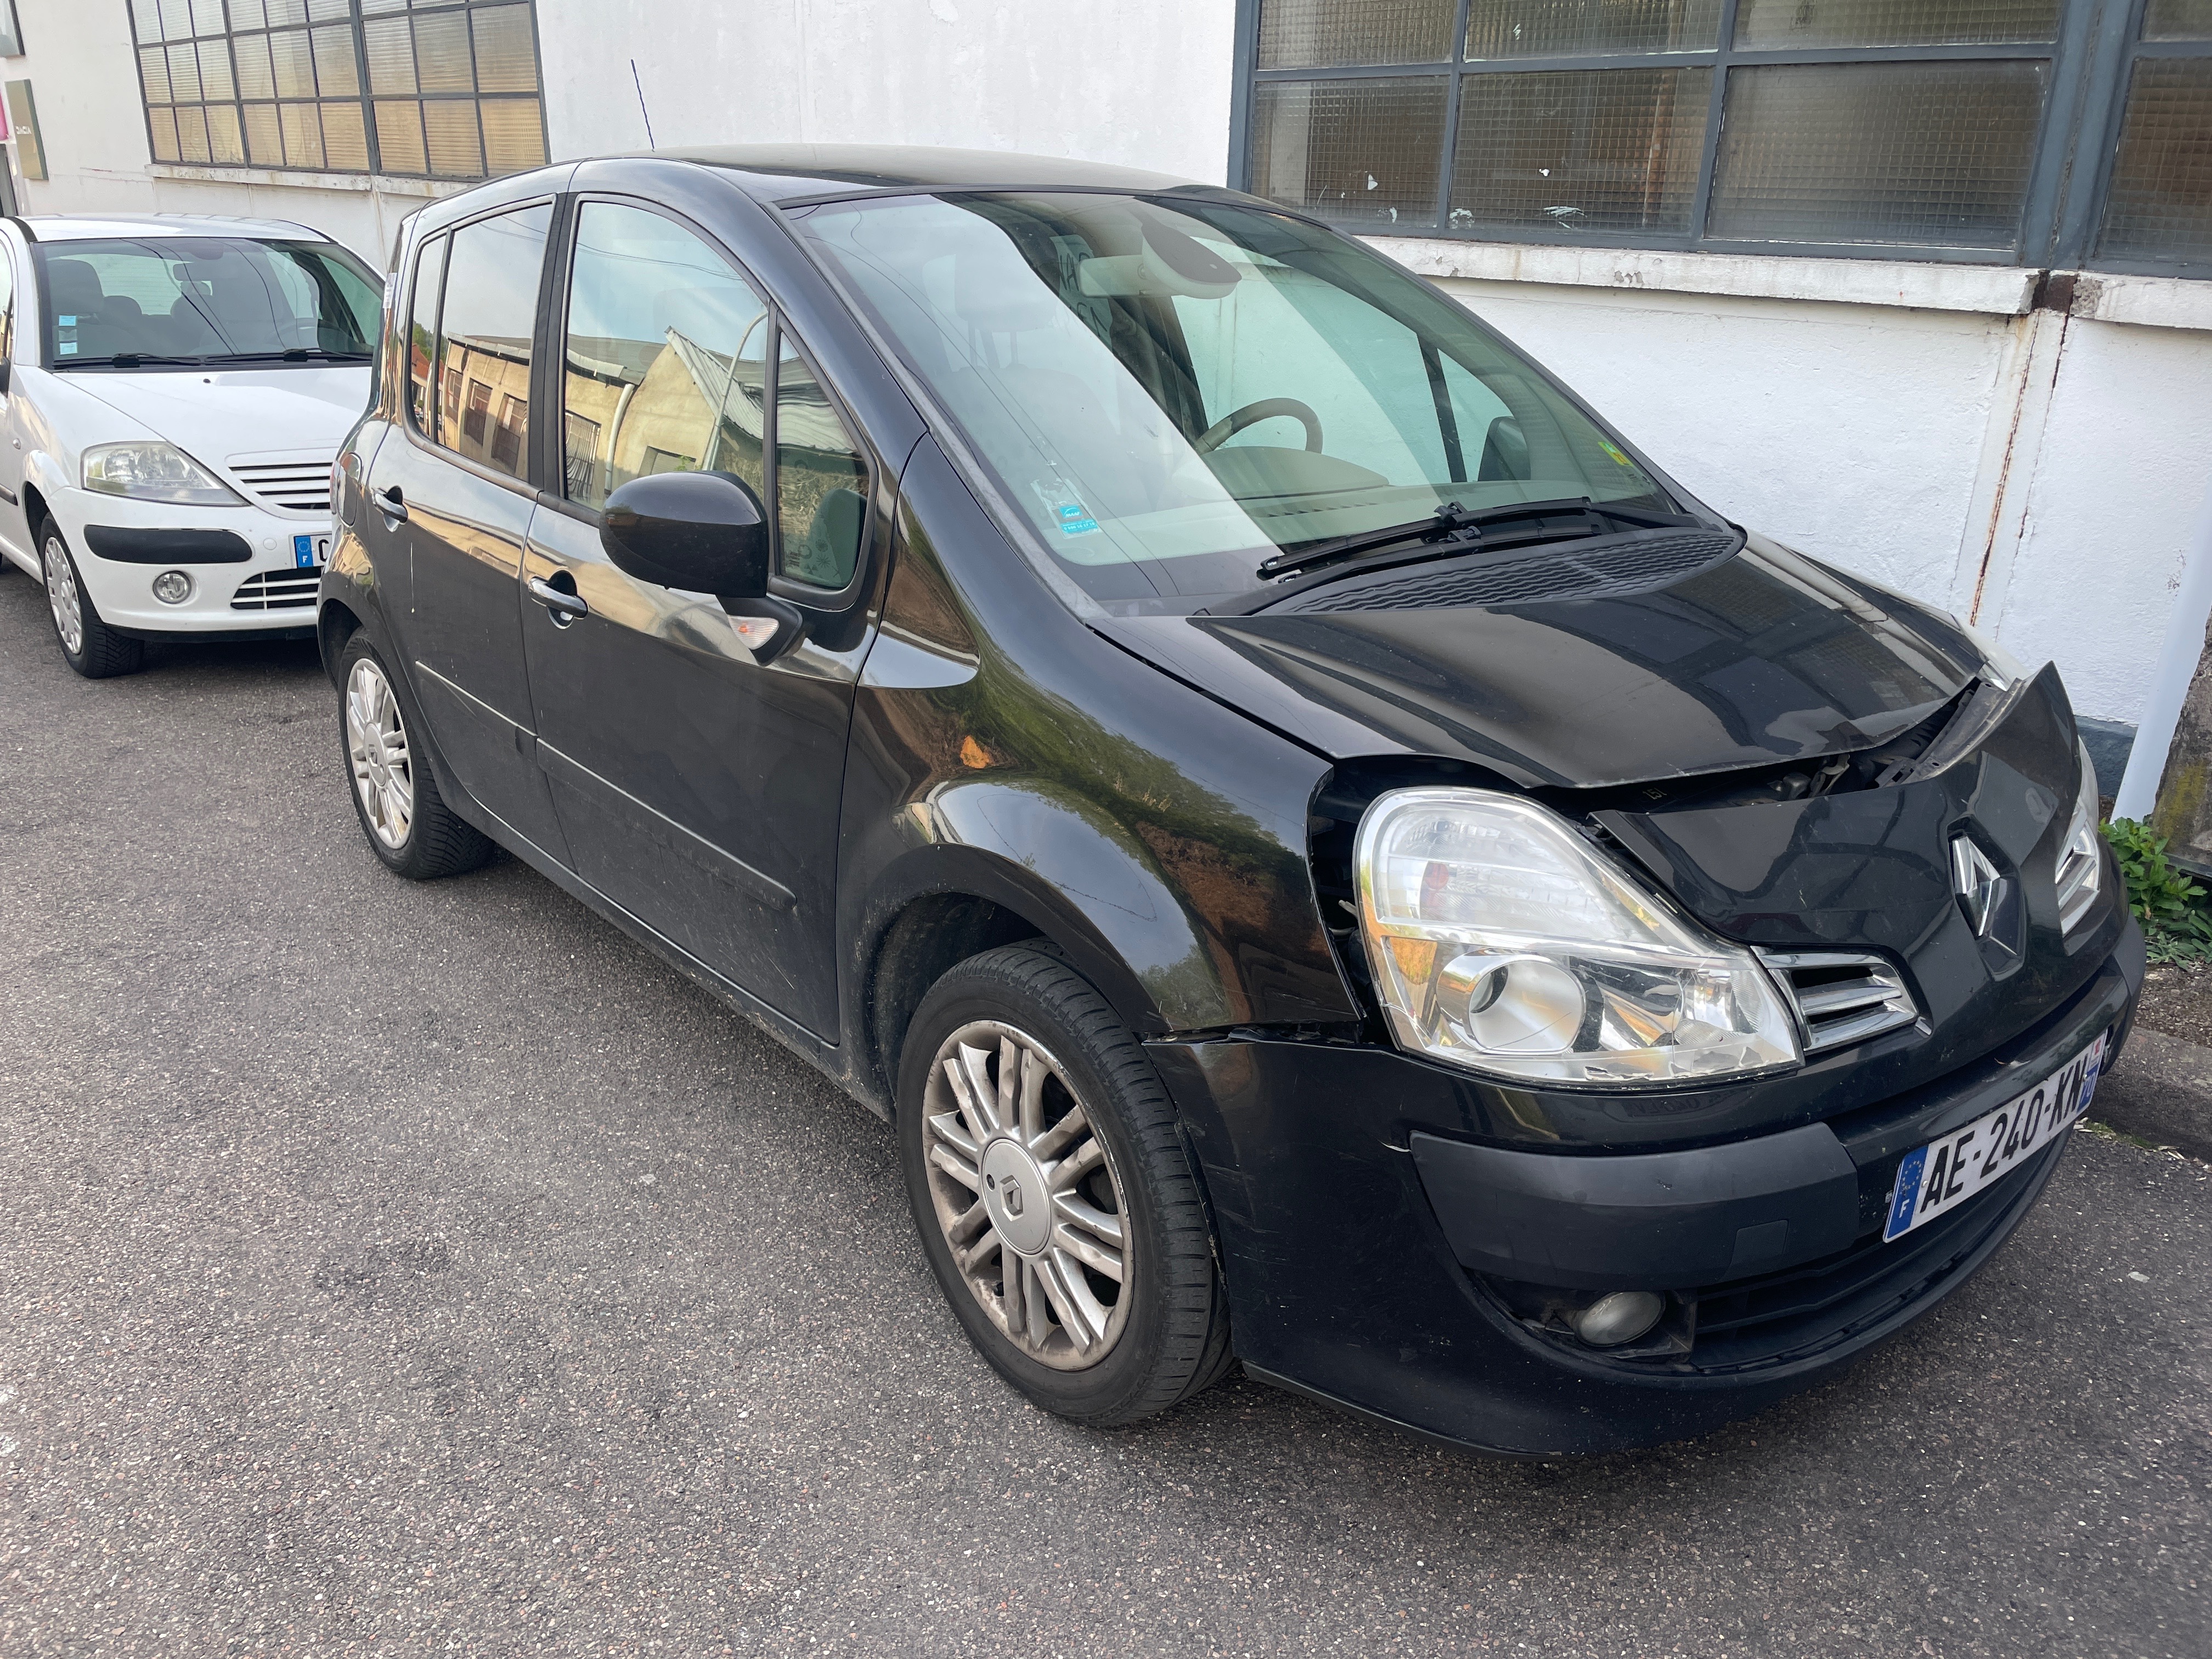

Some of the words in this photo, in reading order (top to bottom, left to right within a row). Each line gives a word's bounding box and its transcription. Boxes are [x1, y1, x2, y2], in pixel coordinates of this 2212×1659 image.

[302, 555, 308, 563] F
[1920, 1052, 2089, 1214] AE-240-KN
[1899, 1199, 1910, 1218] F
